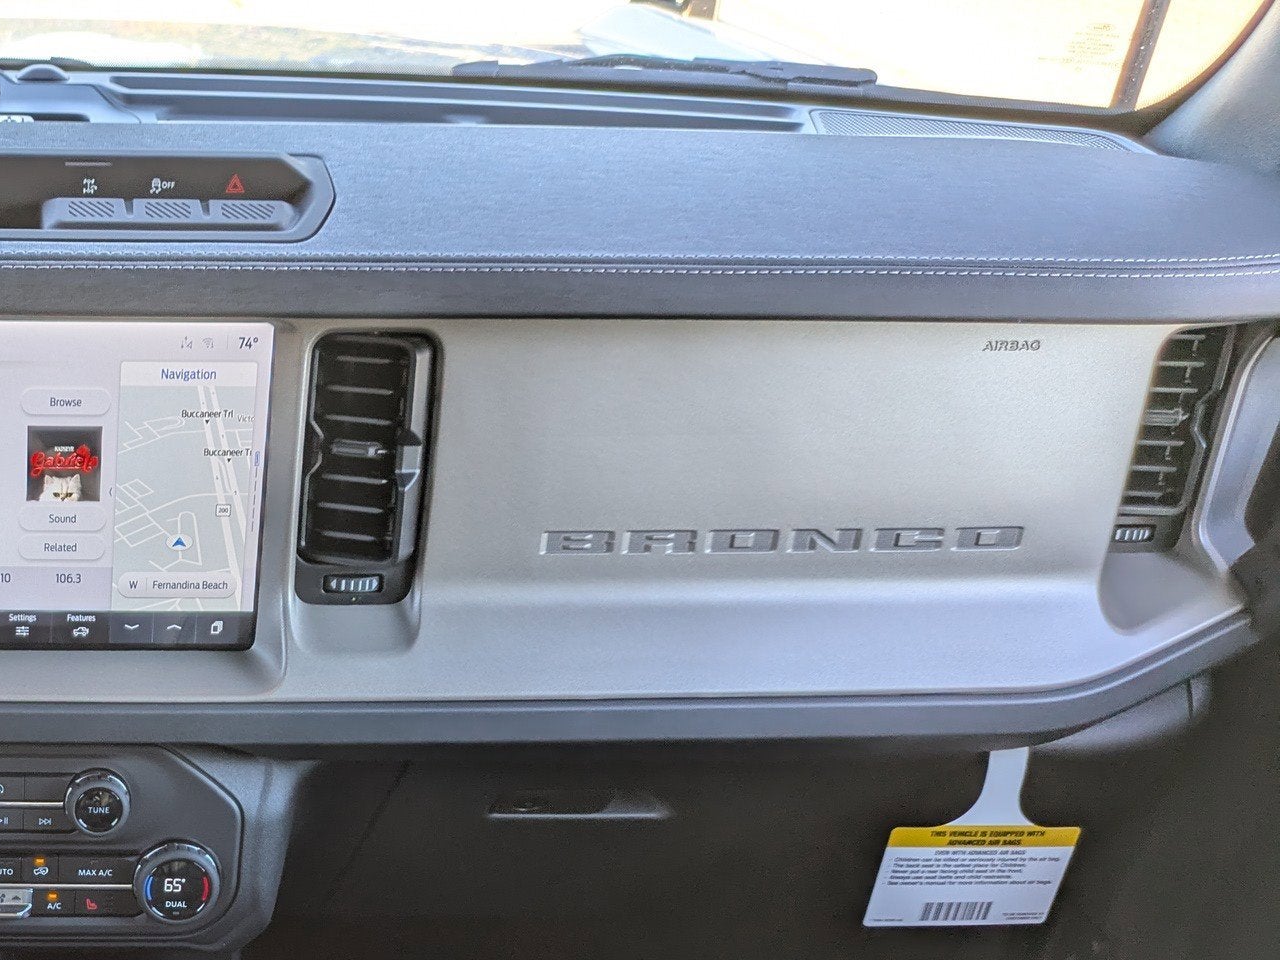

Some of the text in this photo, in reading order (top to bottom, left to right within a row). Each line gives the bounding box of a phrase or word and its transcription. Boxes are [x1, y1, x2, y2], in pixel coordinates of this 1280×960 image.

[162, 180, 175, 190] OFF
[238, 336, 259, 350] 74°
[982, 340, 1041, 352] AIRBAG
[160, 368, 218, 381] Navigation
[49, 397, 83, 408] Browse
[181, 409, 221, 419] Buccaneer
[203, 447, 244, 457] Buccaneer
[48, 513, 77, 524] Sound
[539, 525, 1026, 556] BRONCO
[43, 542, 78, 553] Related
[55, 573, 82, 585] 106.3
[129, 580, 139, 590] W
[152, 580, 229, 590] Fernandina Beach
[8, 613, 37, 623] Settings
[66, 614, 96, 623] Features
[88, 806, 110, 815] TUNE
[98, 869, 113, 877] A/C
[164, 878, 186, 892] 65°
